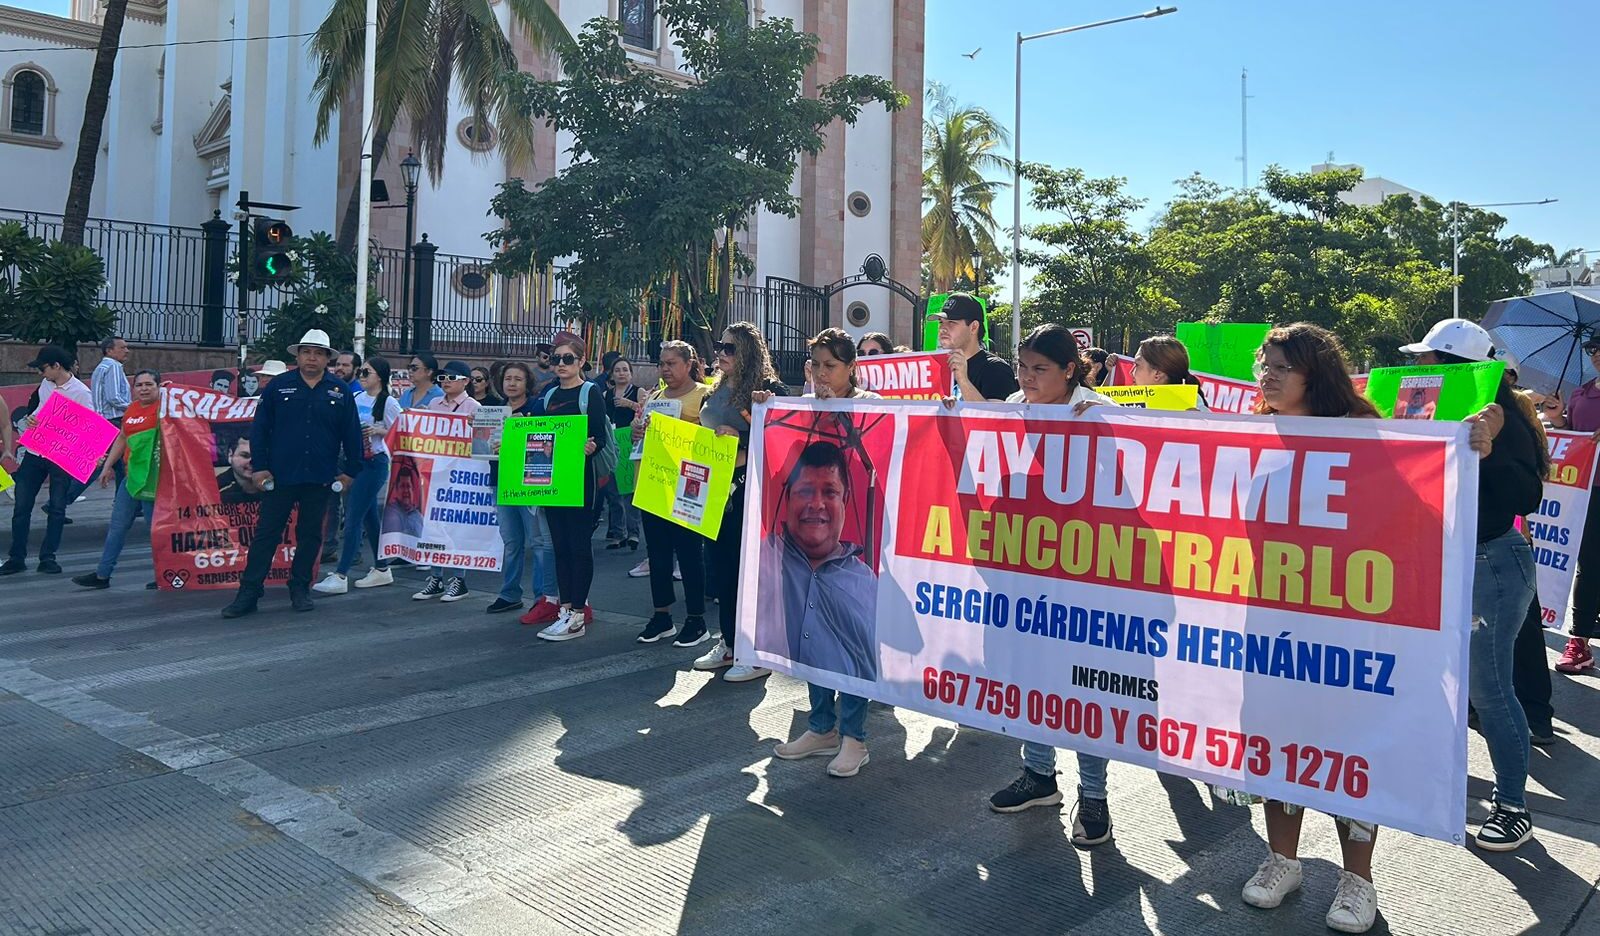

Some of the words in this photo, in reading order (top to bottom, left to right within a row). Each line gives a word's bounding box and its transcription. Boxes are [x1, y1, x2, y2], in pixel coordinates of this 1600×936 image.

[1400, 377, 1444, 389] DESAPARECIDO
[956, 429, 1351, 530] AYUDAME
[177, 506, 191, 519] 14
[196, 502, 242, 518] OCTUBRE
[171, 528, 233, 553] HAZIEL
[194, 549, 240, 569] 667
[424, 551, 431, 560] Y
[432, 552, 452, 564] 667
[453, 554, 471, 567] 573
[473, 556, 496, 568] 1276
[921, 505, 953, 556] A
[966, 508, 1394, 615] ENCONTRARLO
[915, 581, 1009, 628] SERGIO
[1015, 594, 1168, 658] CÁRDENAS
[1177, 623, 1396, 696] HERNÁNDEZ
[1072, 664, 1159, 701] INFORMES
[923, 666, 970, 706] 667
[975, 676, 1021, 719] 759
[1027, 689, 1103, 739] 0900
[1110, 708, 1129, 745] Y
[1137, 713, 1198, 761] 667
[1205, 726, 1271, 777] 573
[1280, 743, 1370, 799] 1276
